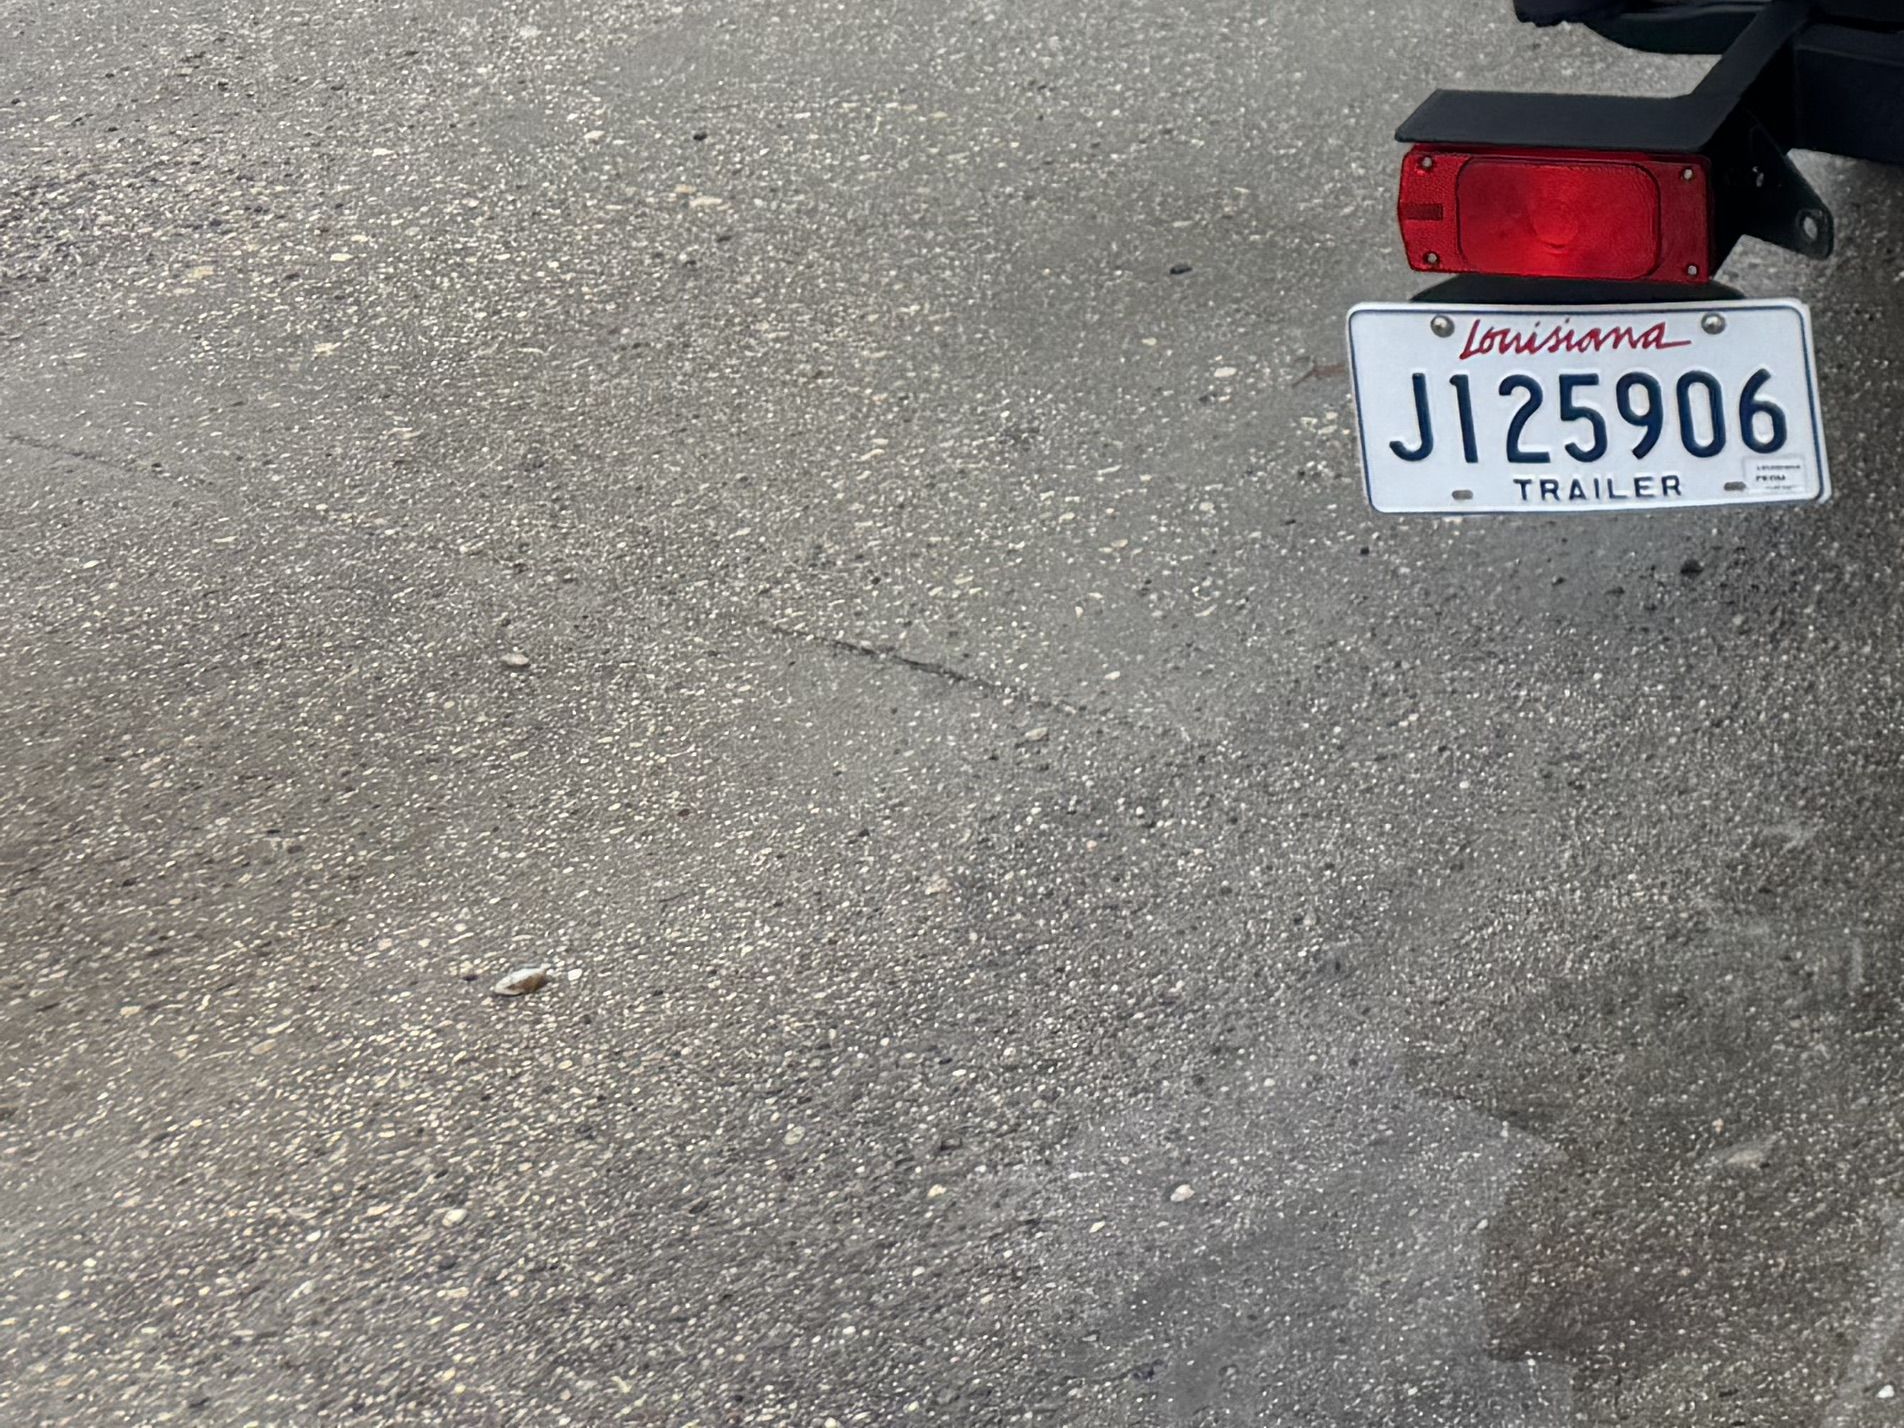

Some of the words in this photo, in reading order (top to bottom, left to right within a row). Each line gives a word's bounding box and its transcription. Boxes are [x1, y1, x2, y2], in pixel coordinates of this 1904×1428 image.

[1459, 318, 1692, 360] Louisiana
[1389, 367, 1788, 465] J125906
[1512, 474, 1683, 502] TRAILER
